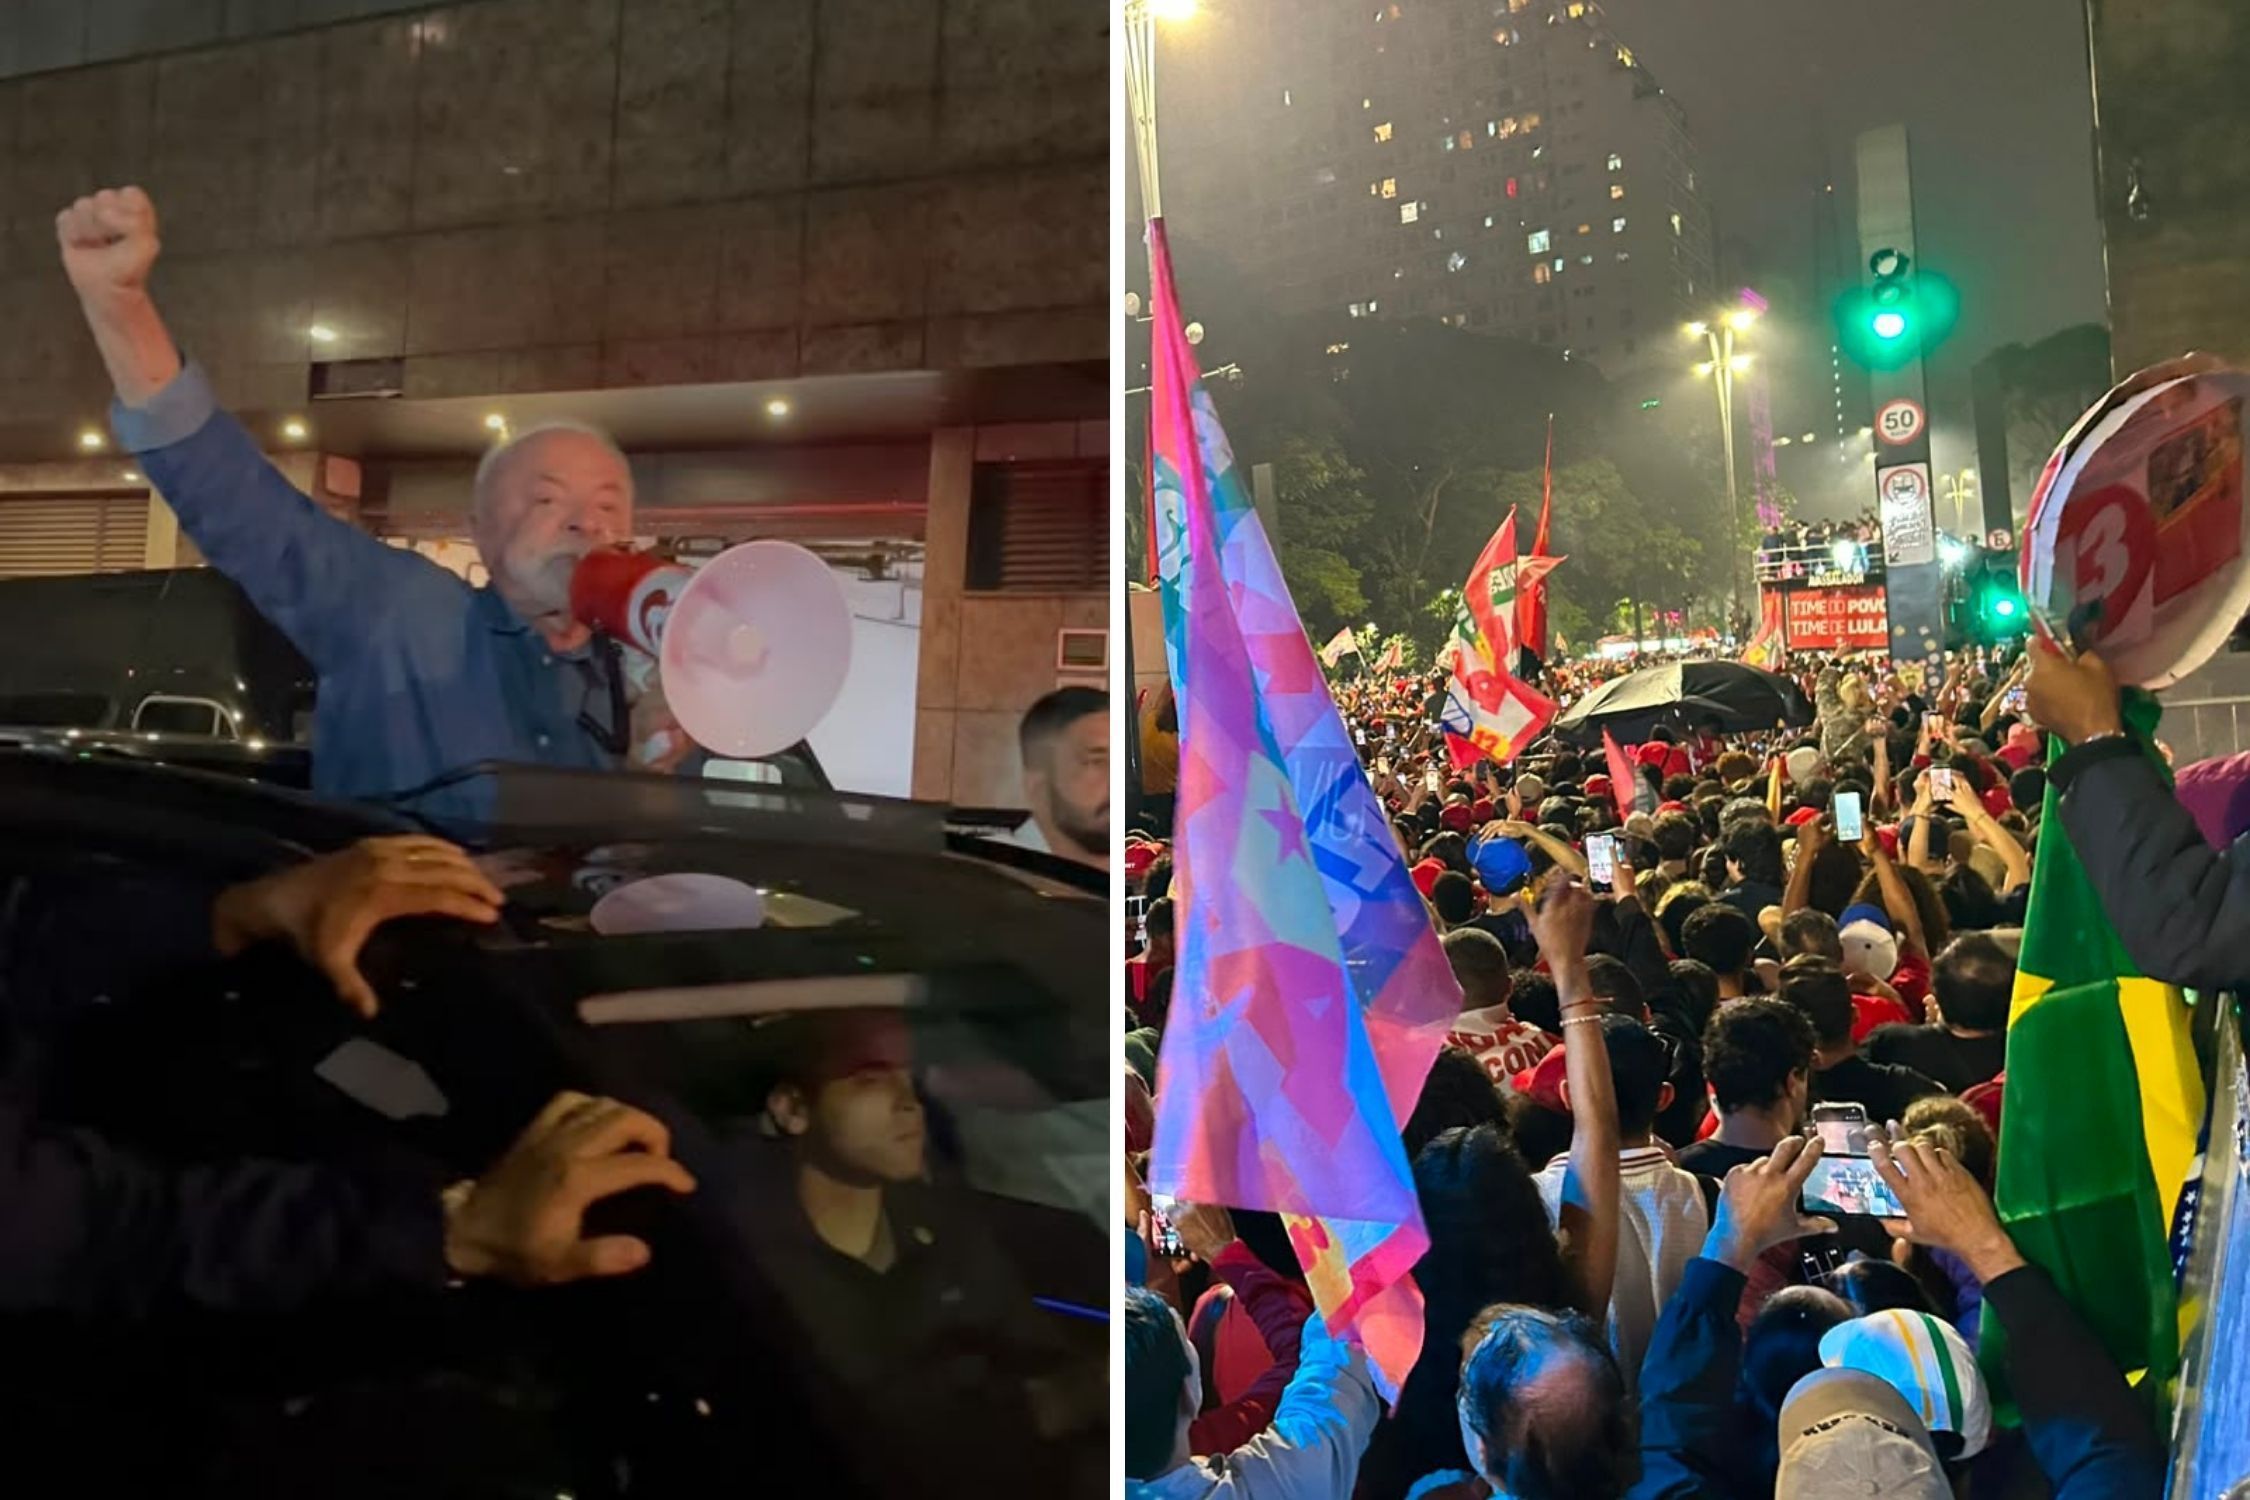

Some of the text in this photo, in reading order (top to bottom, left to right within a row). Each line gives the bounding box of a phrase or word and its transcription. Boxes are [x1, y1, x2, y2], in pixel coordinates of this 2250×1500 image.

[1885, 409, 1914, 430] 50
[1791, 599, 1828, 616] TIME
[1828, 599, 1846, 615] DO
[1791, 617, 1888, 637] TIME DE LULA
